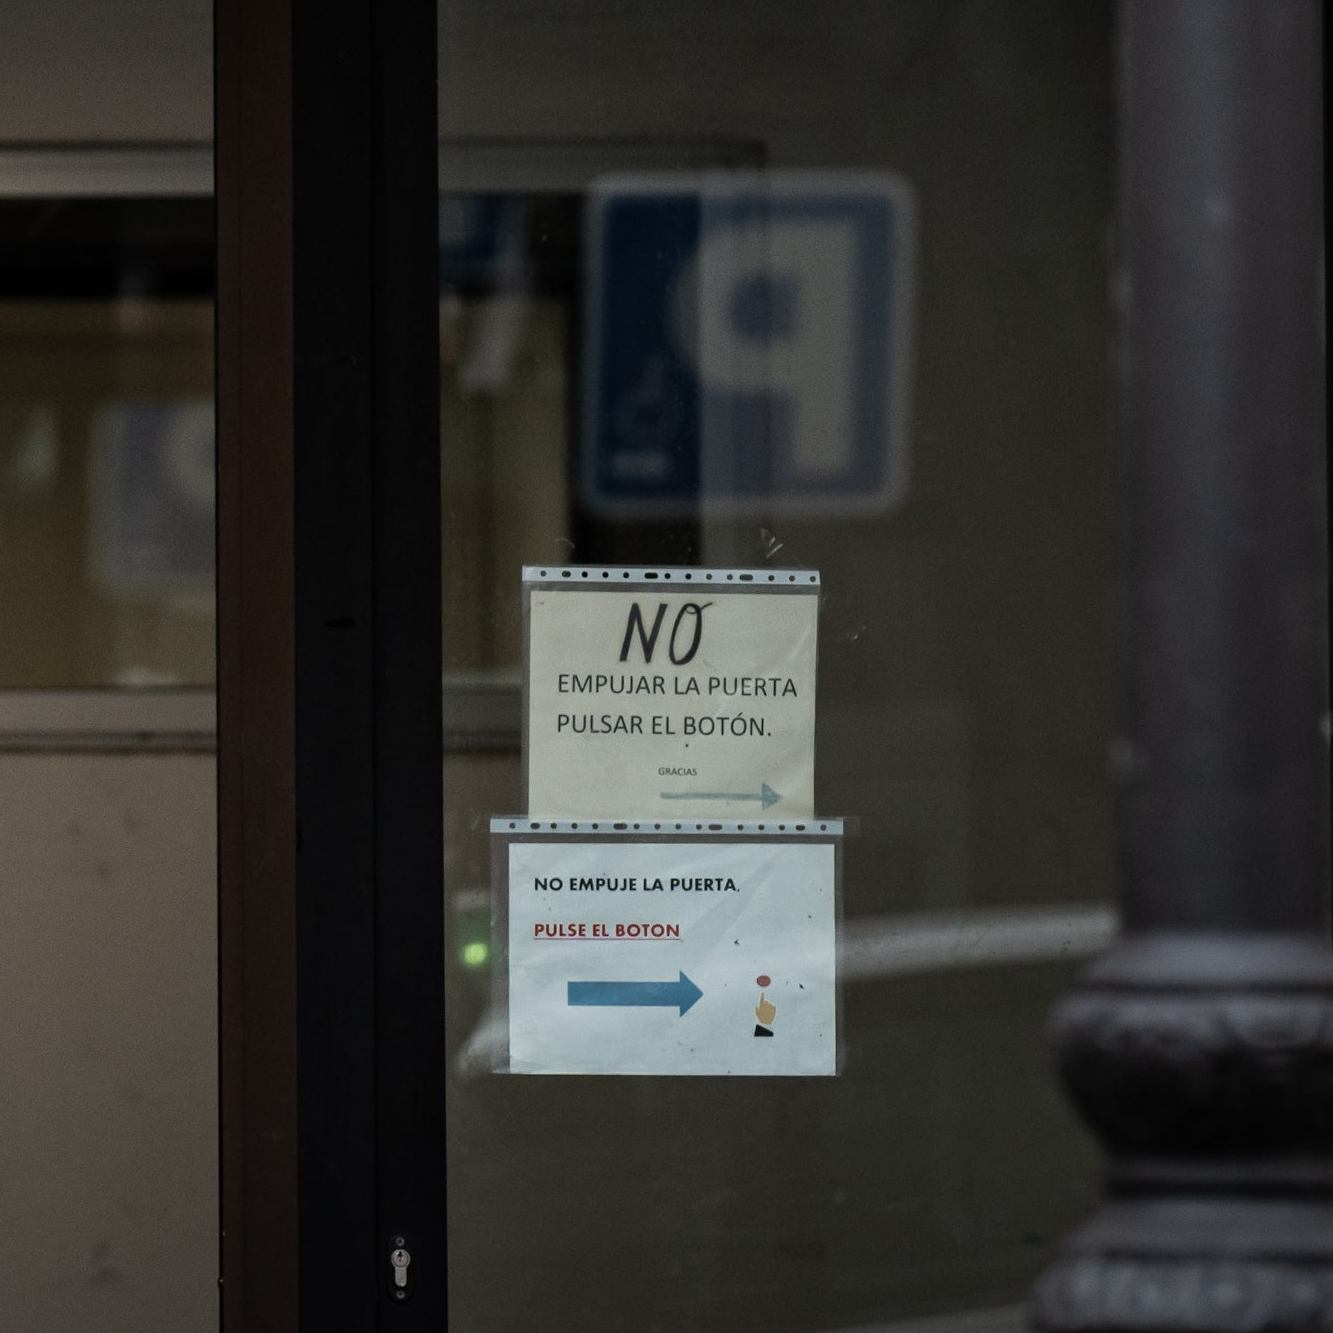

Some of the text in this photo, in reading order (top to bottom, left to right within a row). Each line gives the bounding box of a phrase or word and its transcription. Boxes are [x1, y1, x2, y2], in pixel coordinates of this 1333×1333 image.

[619, 602, 713, 666] NO
[558, 674, 797, 697] EMPUJAR LA PUERTA
[558, 712, 772, 737] PULSAR EL BOTÓN.
[658, 767, 698, 776] GRACIAS
[534, 878, 564, 891] NO
[569, 878, 637, 892] EMPUJE
[643, 878, 664, 891] LA
[534, 923, 680, 938] PULSE EL BOTON
